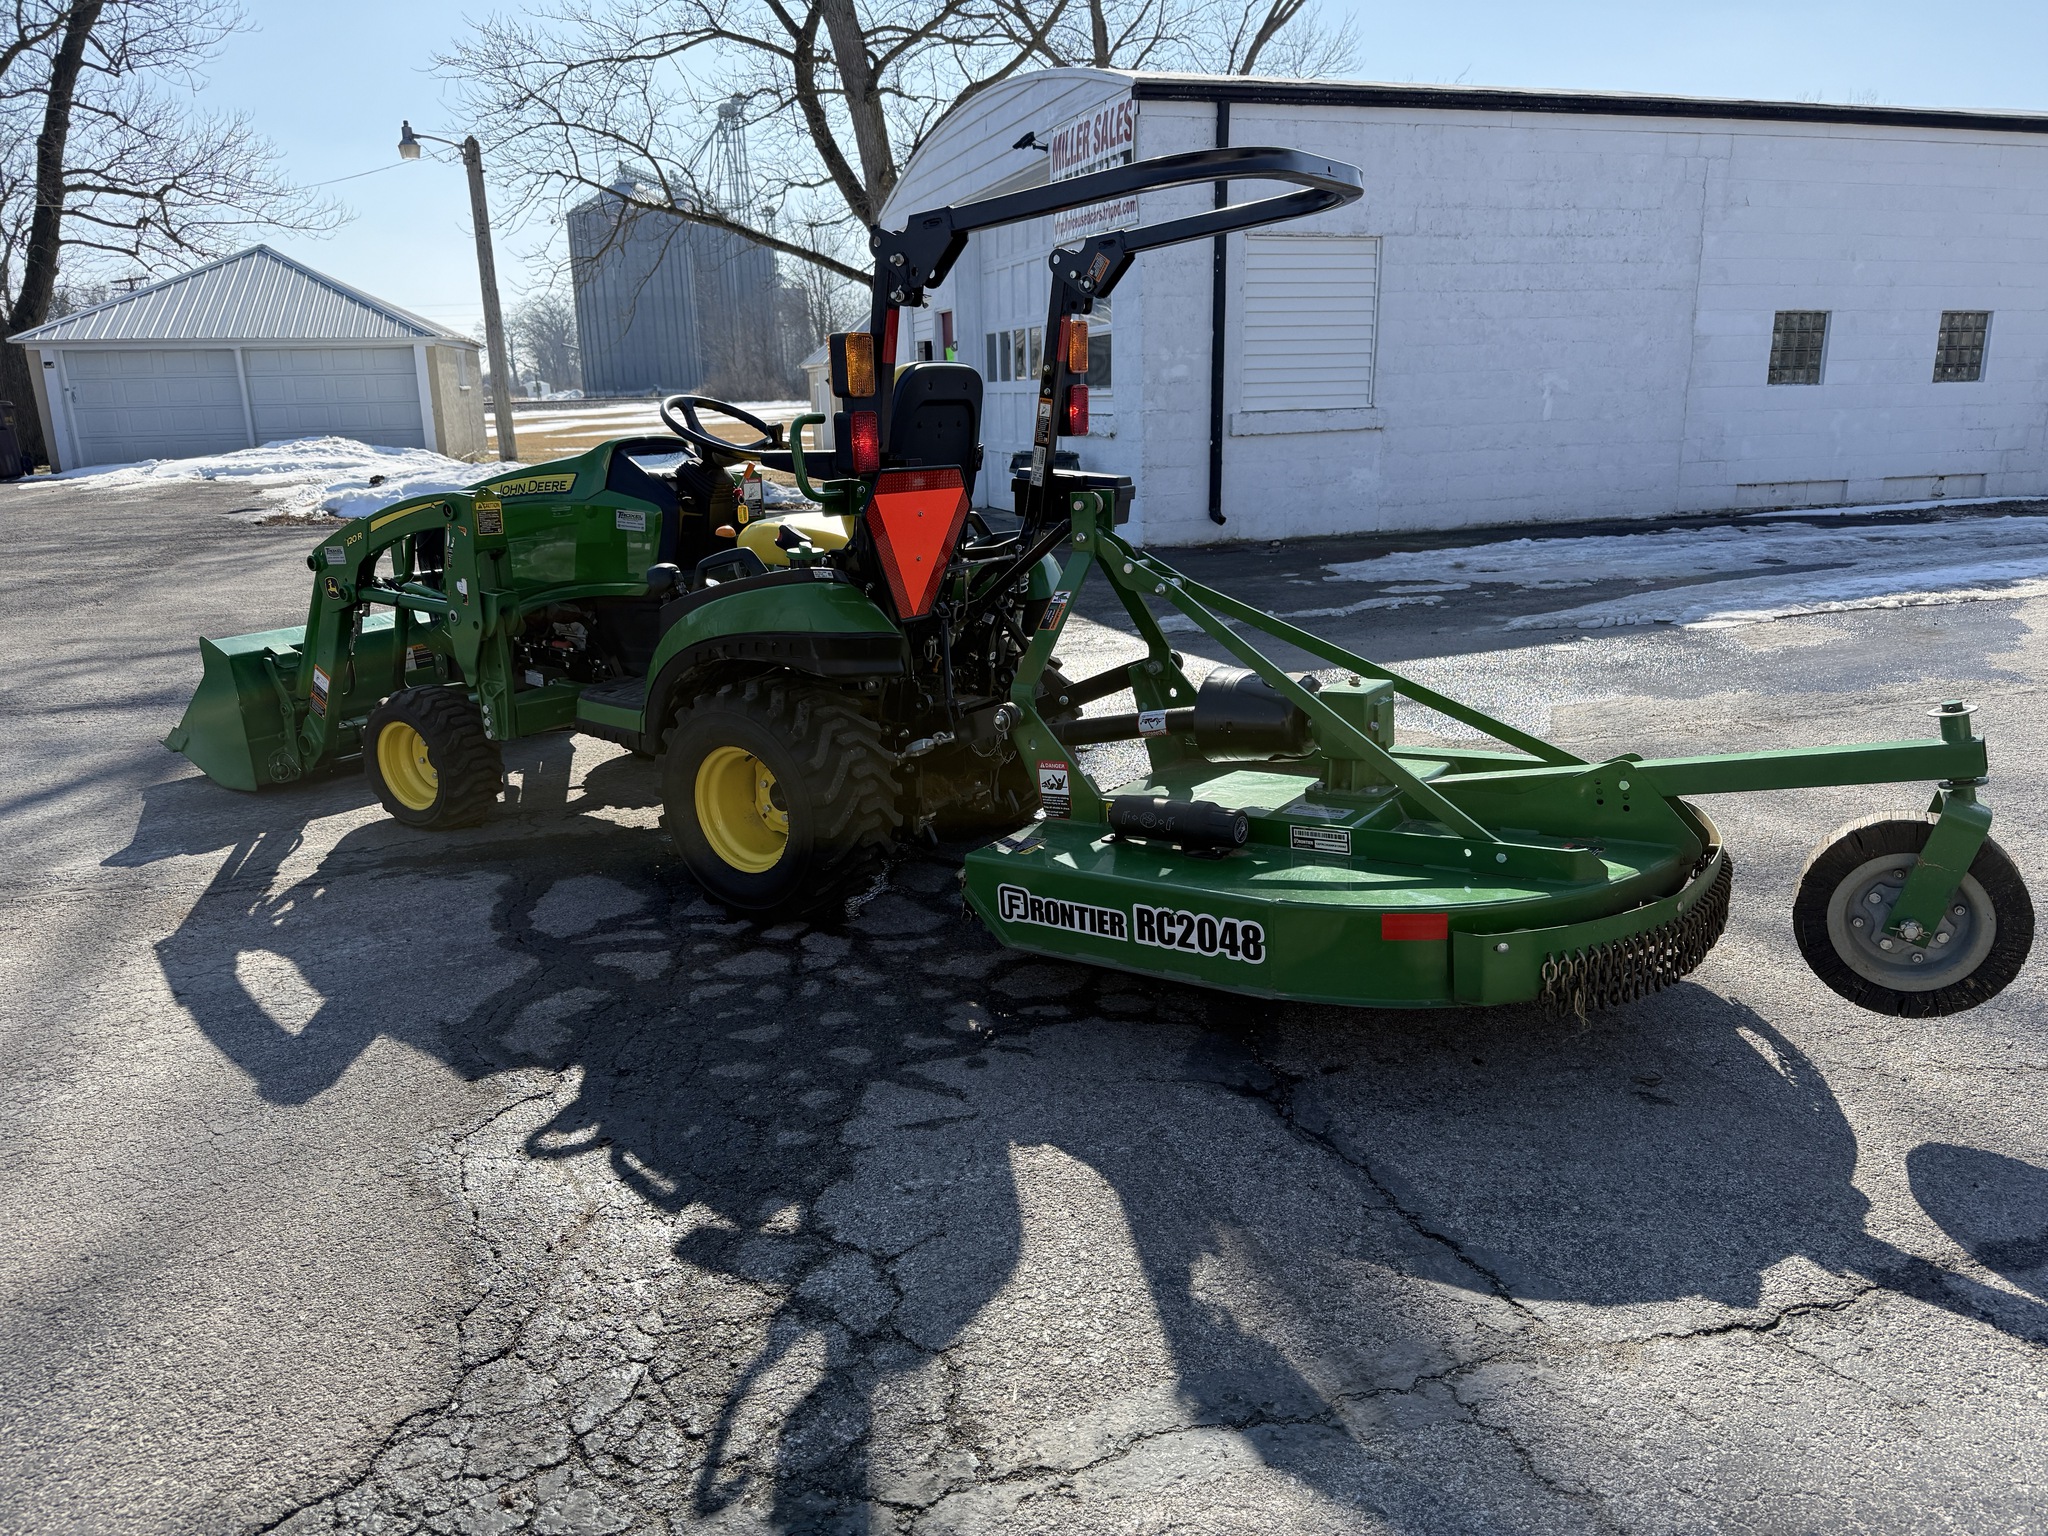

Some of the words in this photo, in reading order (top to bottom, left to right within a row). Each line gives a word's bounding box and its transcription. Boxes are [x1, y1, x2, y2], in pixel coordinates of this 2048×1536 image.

[1052, 119, 1091, 174] MILLER
[1093, 98, 1133, 156] SALES
[500, 483, 526, 496] JOHN
[528, 480, 567, 493] DEERE
[998, 884, 1128, 940] FRONTIER
[1134, 905, 1264, 962] RC2048
